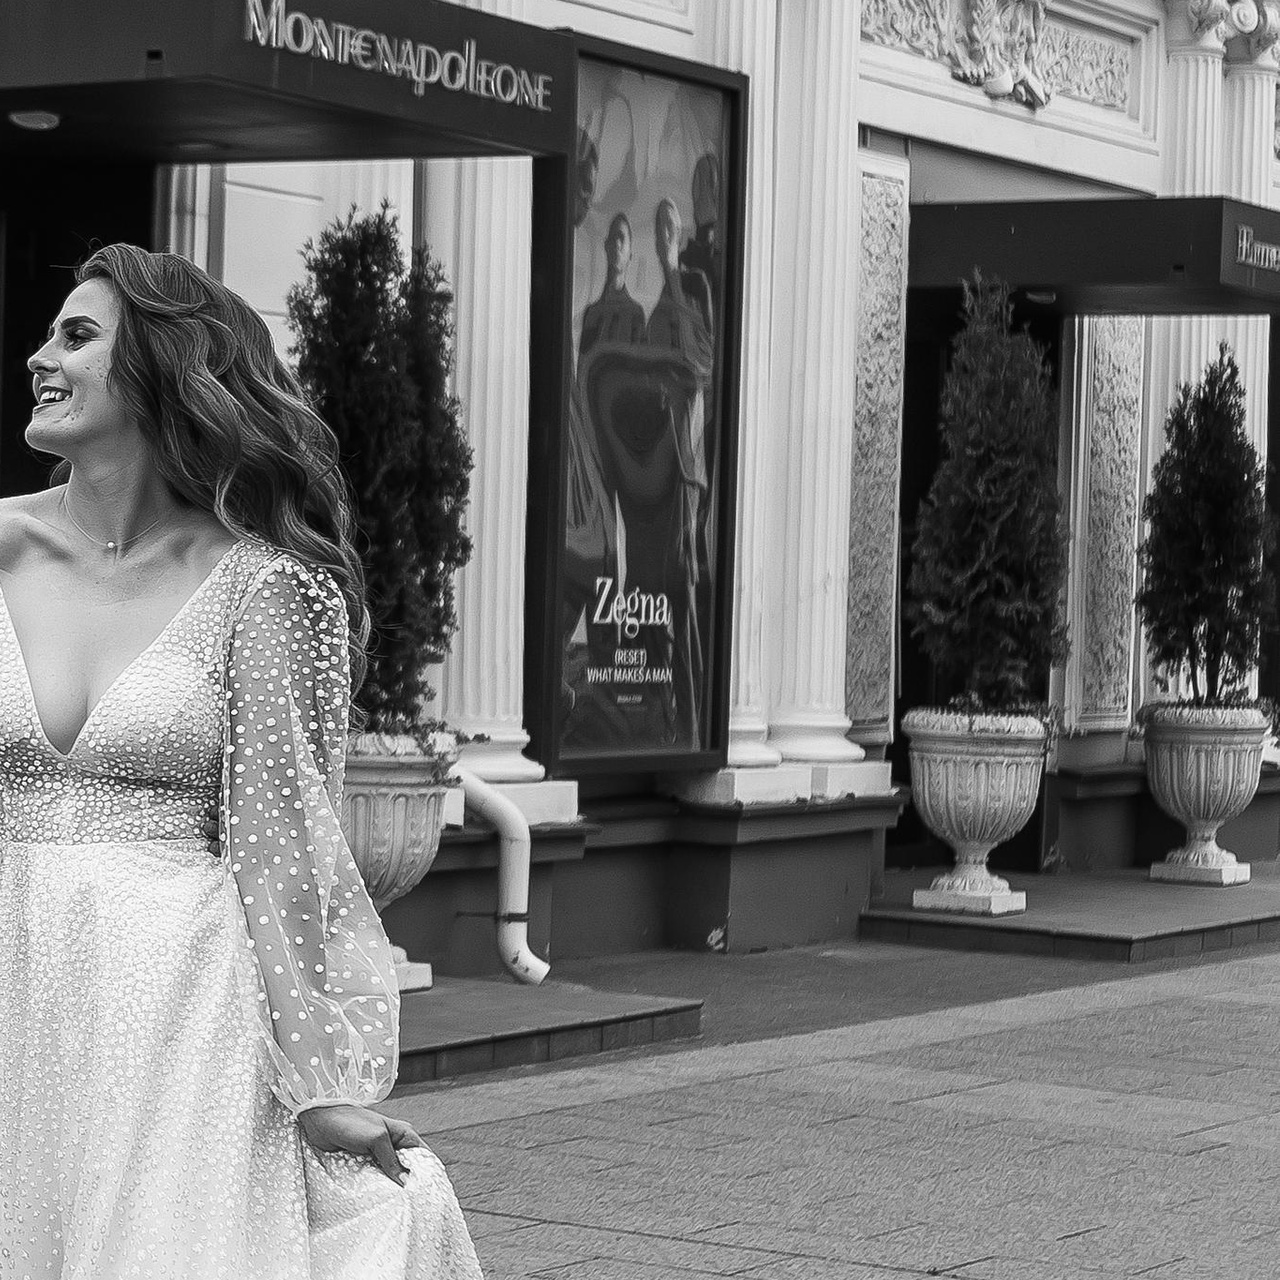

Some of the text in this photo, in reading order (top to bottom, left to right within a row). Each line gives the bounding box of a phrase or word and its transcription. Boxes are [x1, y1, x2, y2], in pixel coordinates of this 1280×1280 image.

[593, 576, 670, 638] Zegna
[614, 648, 647, 666] (RESET)
[587, 668, 613, 683] WHAT
[614, 668, 645, 683] MAKES
[652, 668, 673, 683] MAN
